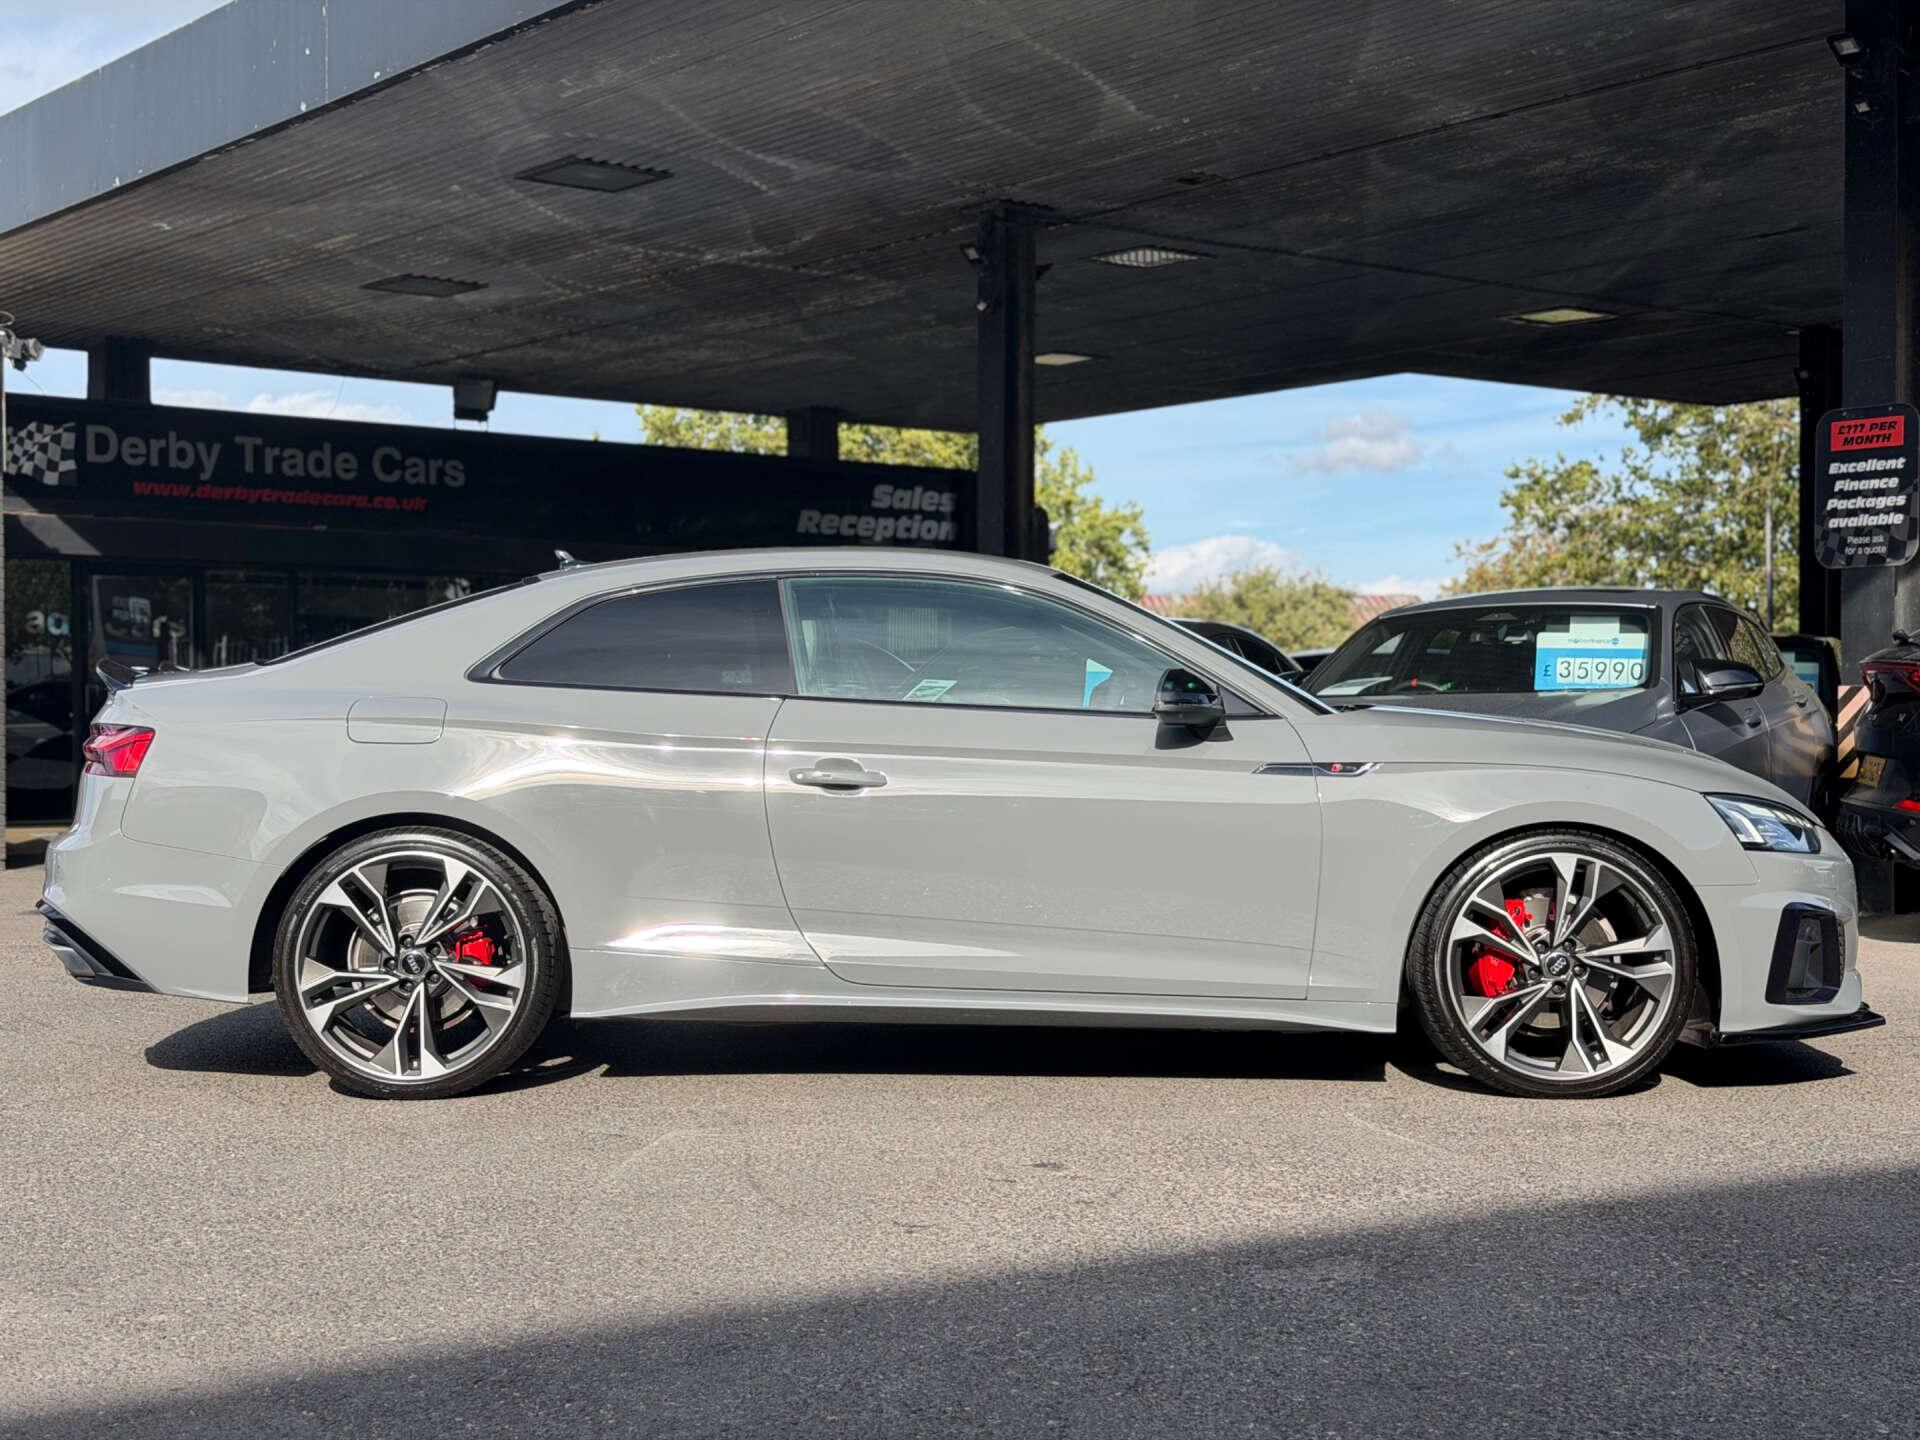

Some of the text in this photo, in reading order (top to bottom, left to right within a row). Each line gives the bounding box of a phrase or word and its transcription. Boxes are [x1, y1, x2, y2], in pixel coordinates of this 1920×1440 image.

[1869, 420, 1898, 432] PER
[1841, 433, 1892, 447] MONTH
[85, 425, 466, 487] Derby Trade Cars
[1829, 457, 1906, 475] Excellent
[1834, 476, 1900, 492] Finance
[133, 479, 428, 512] www.derbytradecars.co.uk
[871, 484, 956, 512] Sales
[1826, 494, 1907, 511] Packages
[797, 510, 956, 541] Reception
[1828, 512, 1904, 528] available
[1847, 535, 1884, 544] Please ask
[1844, 546, 1856, 554] for
[1863, 545, 1887, 556] quote
[1542, 660, 1644, 681] £ 35990
